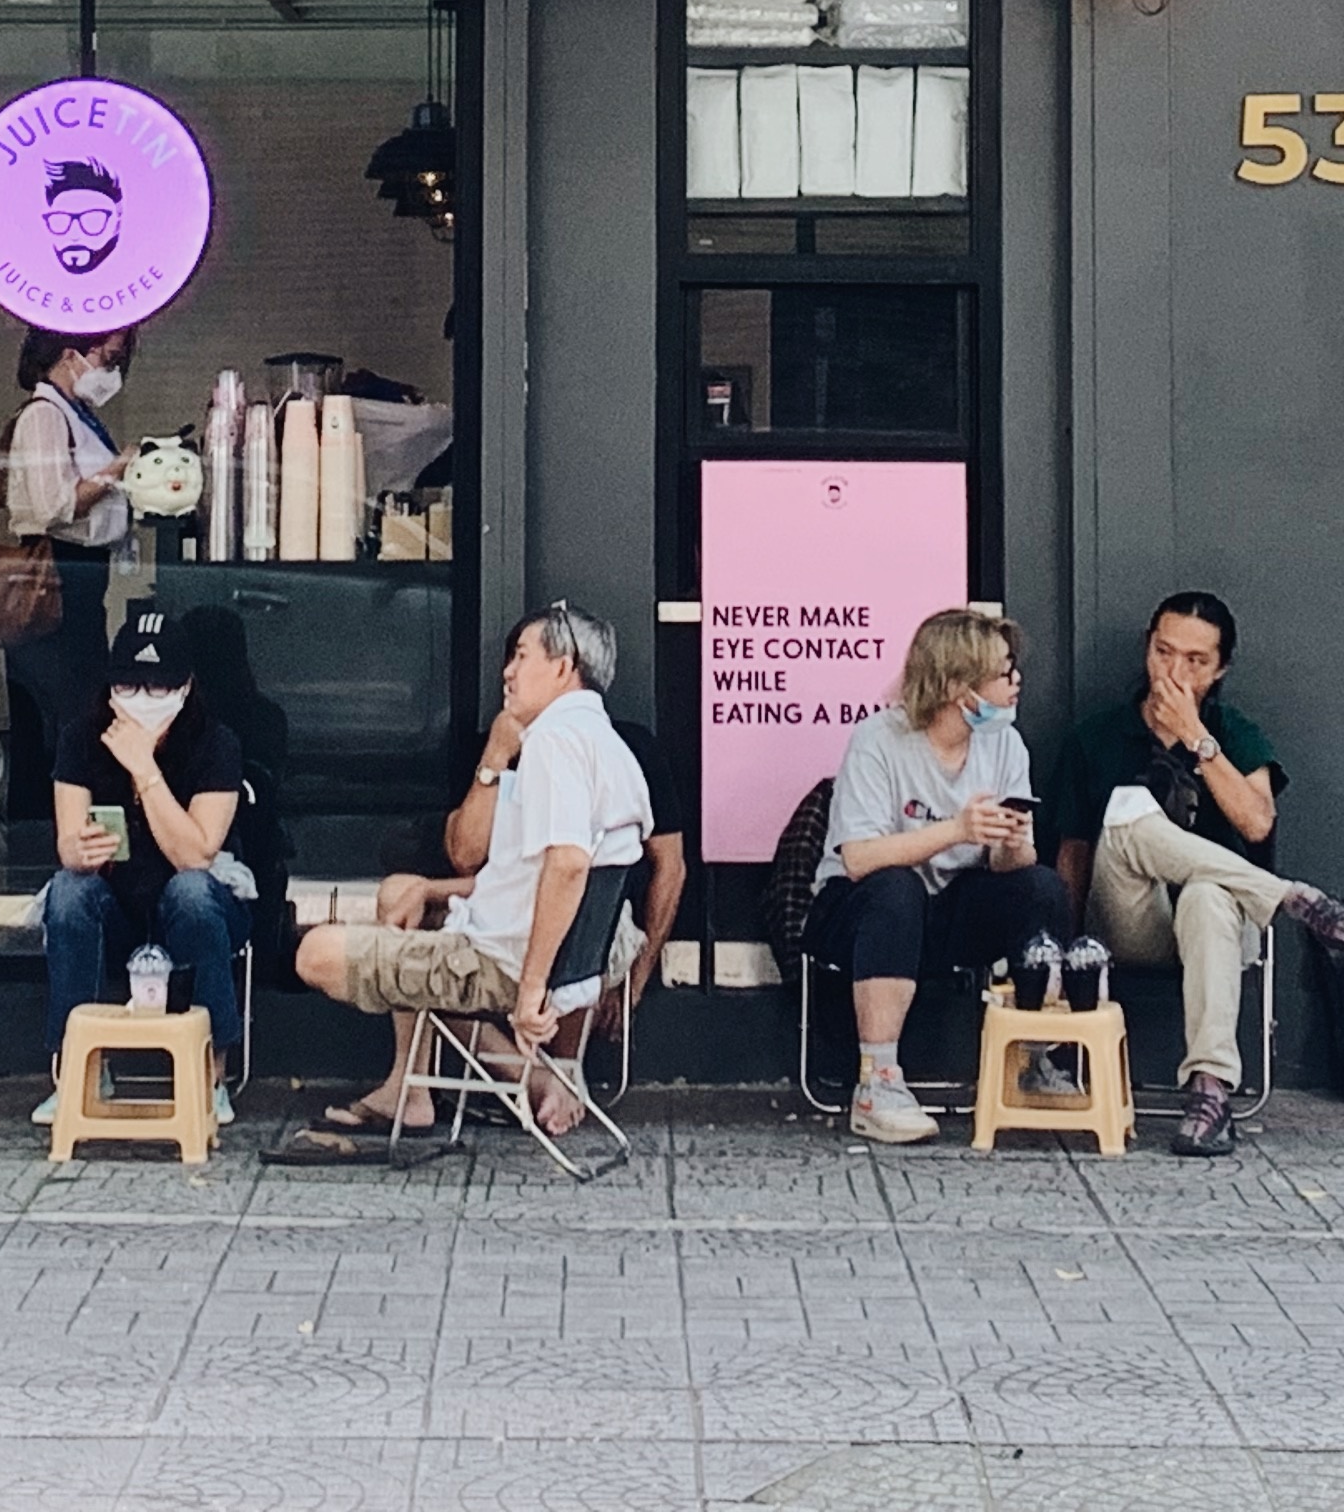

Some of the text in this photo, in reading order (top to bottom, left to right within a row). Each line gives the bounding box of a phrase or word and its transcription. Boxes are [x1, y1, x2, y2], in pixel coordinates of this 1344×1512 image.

[60, 296, 74, 314] &
[81, 265, 164, 314] COFFEE
[712, 605, 871, 628] NEVER MAKE
[712, 638, 886, 660] EYE CONTACT
[712, 670, 787, 692] WHILE
[712, 702, 803, 725] EATING
[812, 703, 831, 725] A
